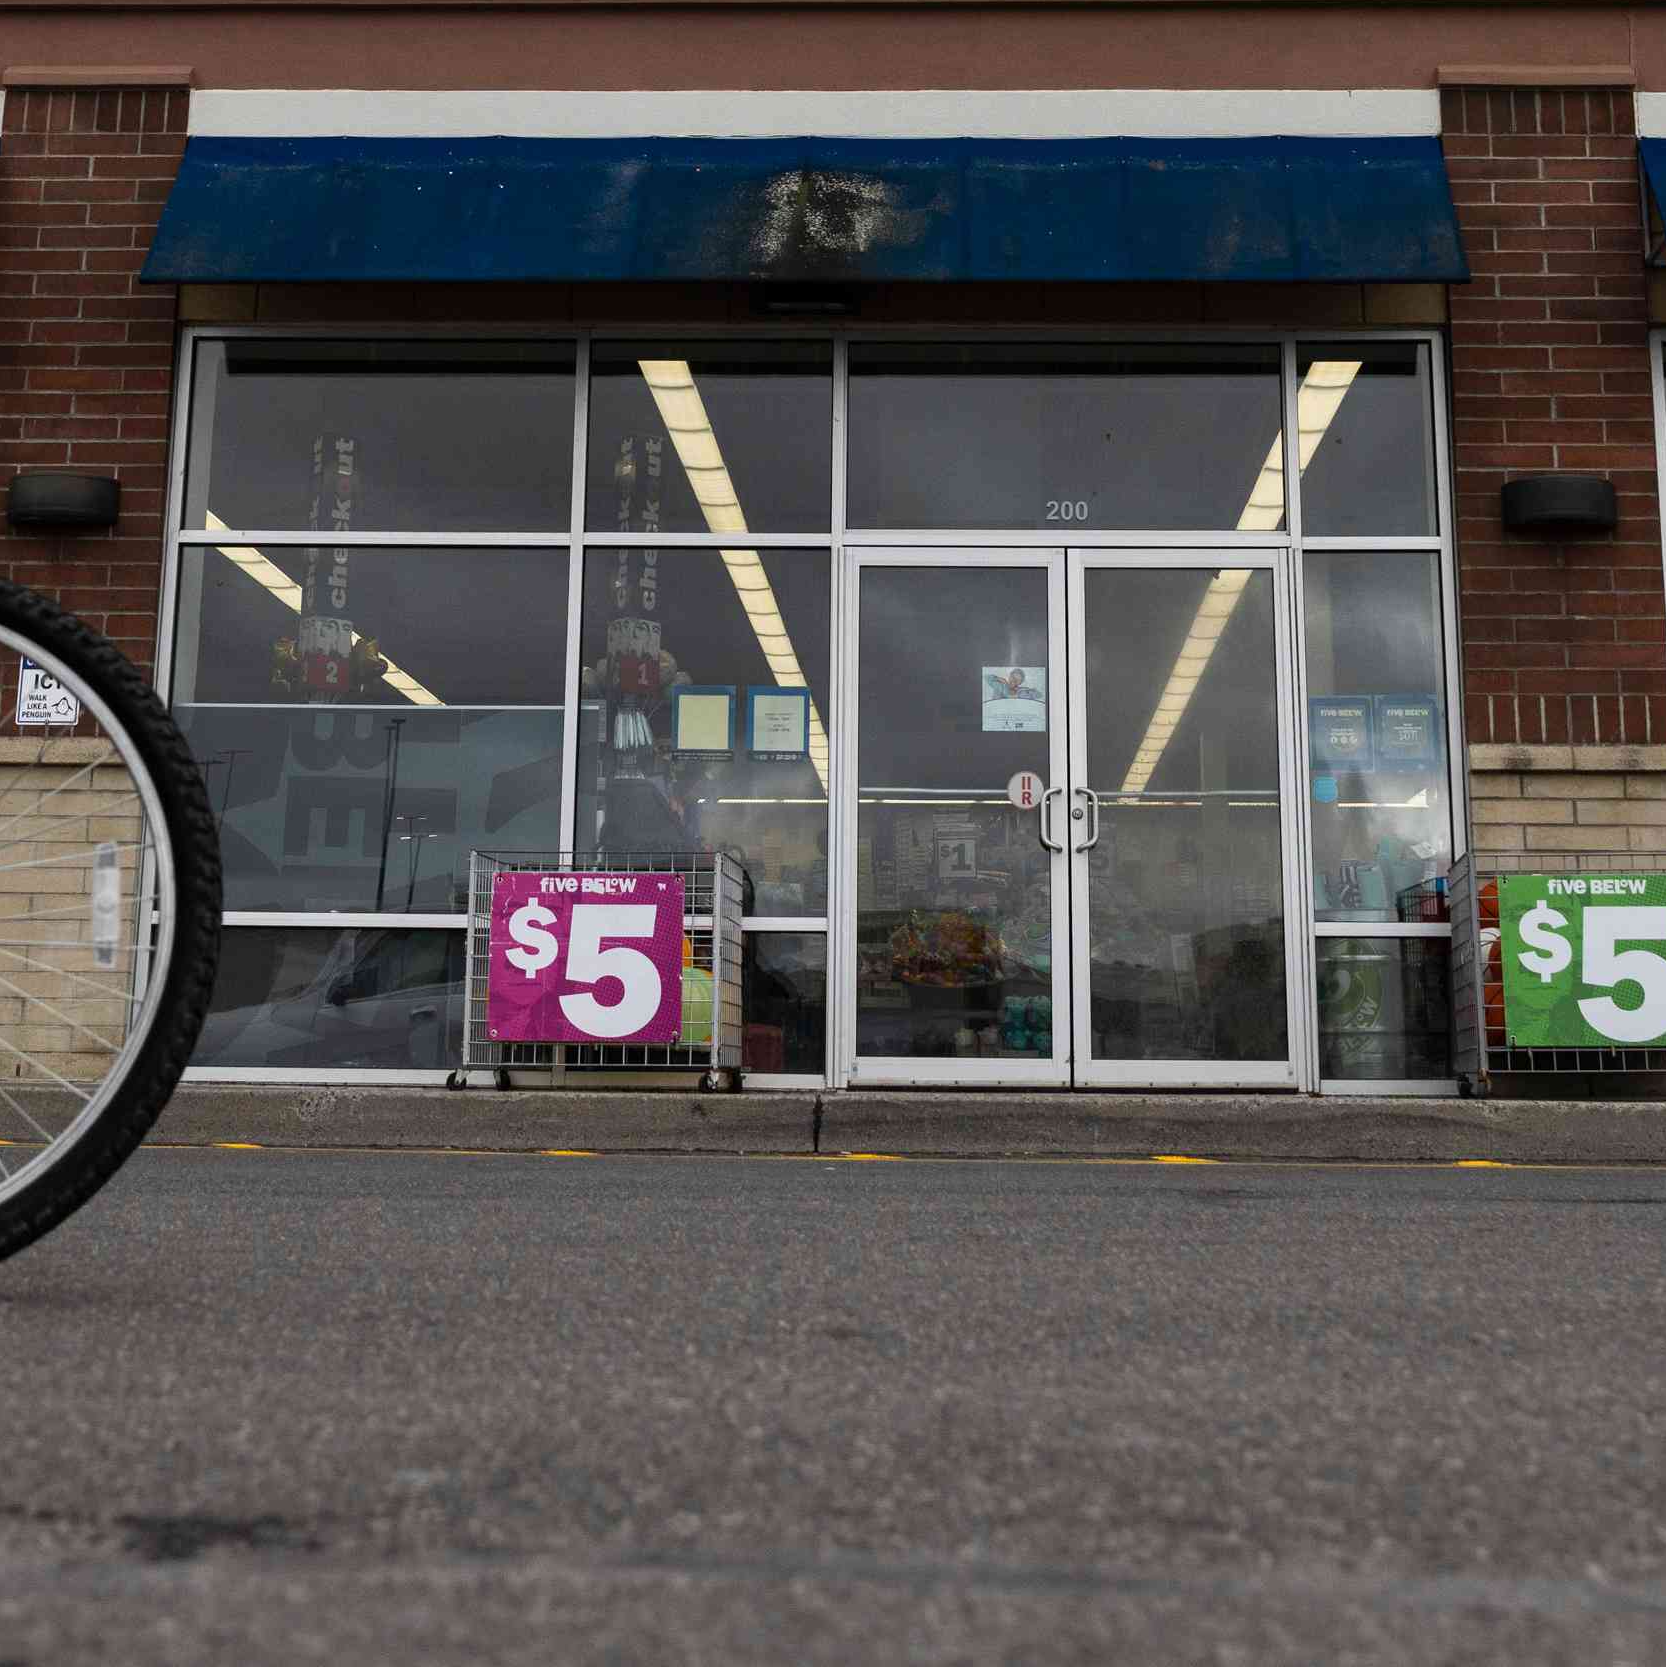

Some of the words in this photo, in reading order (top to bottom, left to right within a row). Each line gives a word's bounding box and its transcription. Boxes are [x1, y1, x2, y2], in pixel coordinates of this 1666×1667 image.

[1045, 500, 1089, 521] 200
[325, 661, 338, 685] 2
[637, 665, 648, 686] 1
[1021, 792, 1032, 805] R
[540, 877, 578, 893] five
[581, 877, 637, 894] BELOW
[1547, 879, 1586, 894] five
[1590, 879, 1646, 894] BELOW
[505, 897, 662, 1038] $5
